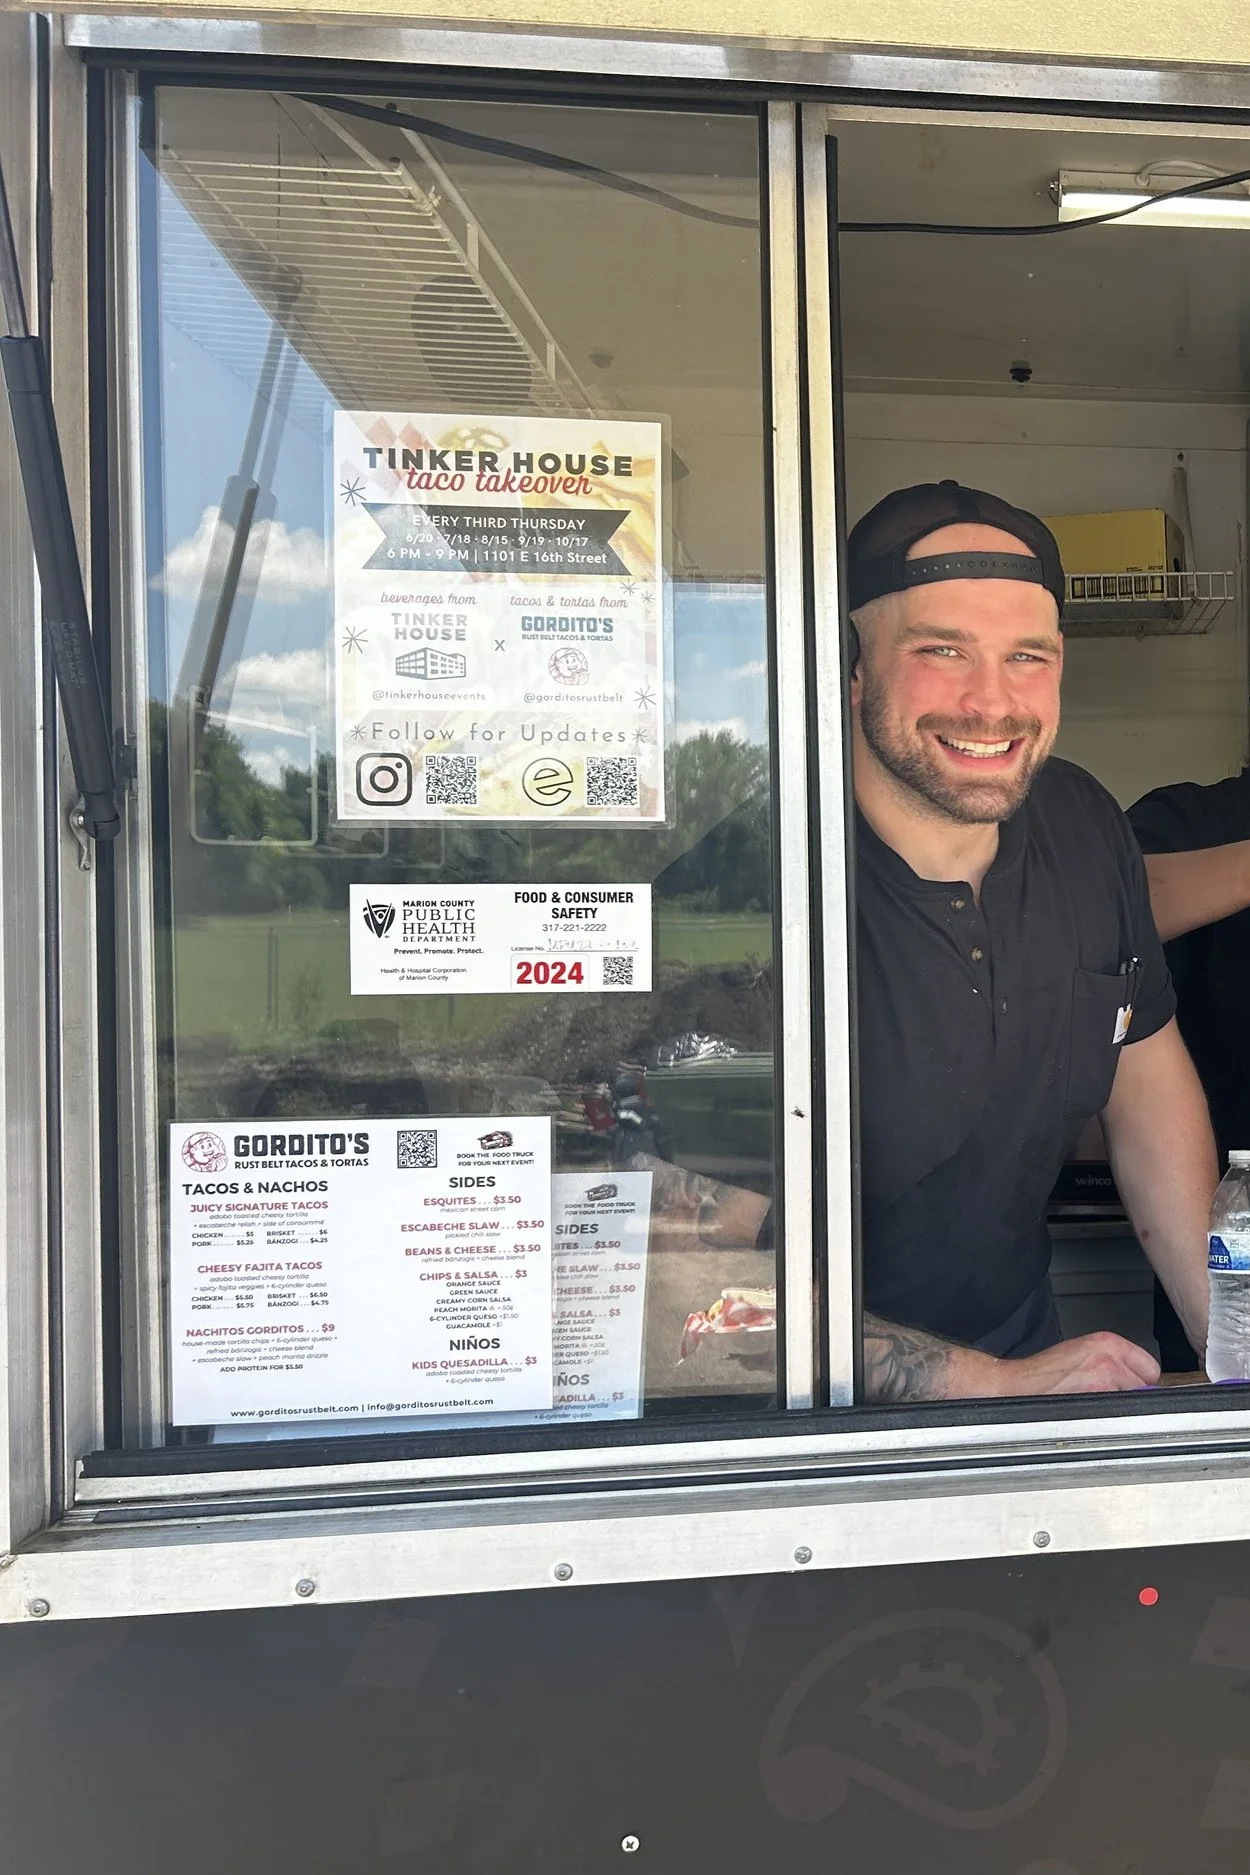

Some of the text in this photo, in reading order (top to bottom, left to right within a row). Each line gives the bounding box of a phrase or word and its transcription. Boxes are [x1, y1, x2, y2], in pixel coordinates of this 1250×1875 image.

[363, 448, 632, 476] TINKER HOUSE
[407, 467, 592, 495] taco takeover
[413, 515, 586, 530] EVERY THIRD THURSDAY
[407, 534, 588, 547] 6/20 7/18 8/15 9/19 10/17
[388, 549, 607, 564] 6 PM 9 PM 1101 E 16th Street
[381, 592, 476, 606] beverages from
[510, 595, 628, 608] tacos & tortas from
[392, 613, 467, 626] TINKER
[521, 616, 613, 633] GORDITO'S
[395, 628, 466, 641] HOUSE
[372, 690, 486, 701] @tinkerhouseevents
[524, 692, 624, 703] @gorditosrustbelt
[372, 722, 626, 745] Follow for Updates
[515, 892, 633, 903] FOOD & CONSUMER
[403, 909, 475, 920] PUBLIC
[552, 908, 598, 919] SAFETY
[402, 923, 474, 934] HEALTH
[542, 924, 606, 932] 317-221-2222
[517, 962, 584, 984] 2024
[234, 1133, 369, 1157] GORDITO'S
[235, 1161, 260, 1169] RUST
[262, 1160, 283, 1168] BELT
[286, 1160, 319, 1168] TACOS
[331, 1159, 368, 1167] TORTAS
[183, 1181, 328, 1196] TACOS & NACHOS
[449, 1176, 496, 1188] SIDES
[190, 1201, 328, 1212] JUICY SIGNATURE TACOS
[424, 1195, 521, 1206] ESQUITES $3.50
[401, 1220, 544, 1232] ESCABECHE SLAW $3.50
[405, 1244, 541, 1256] BEANS & CHEESE $3.50
[198, 1262, 322, 1273] CHEESY FAJITA TACOS
[419, 1269, 527, 1281] CHIPS & SALSA $3
[186, 1323, 335, 1337] NACHITOS GORDITOS $9
[450, 1336, 500, 1351] NIÑOS
[412, 1356, 537, 1370] KIDS QUESADILLA $3
[231, 1404, 359, 1417] www.gorditosrustbelt.com
[367, 1398, 493, 1411] info@gorditosrustbelt.com
